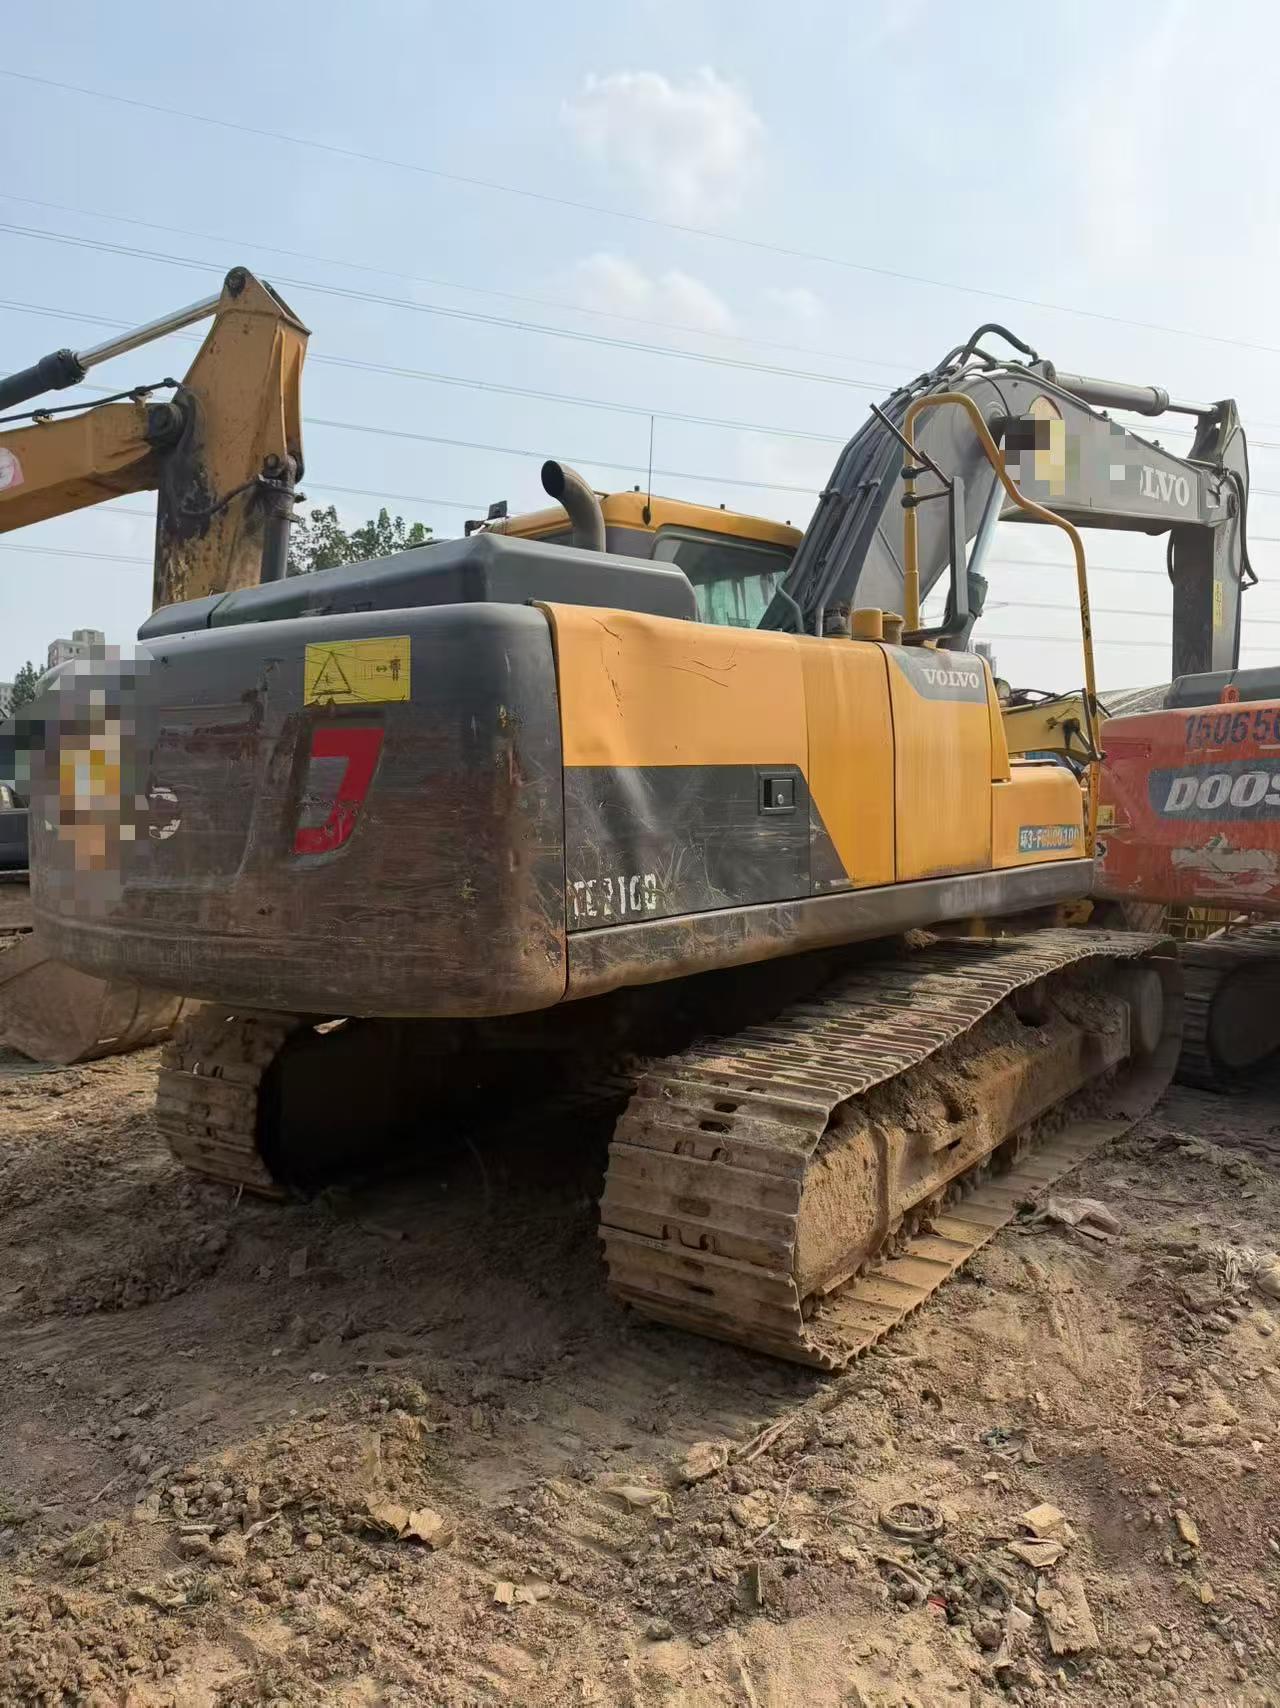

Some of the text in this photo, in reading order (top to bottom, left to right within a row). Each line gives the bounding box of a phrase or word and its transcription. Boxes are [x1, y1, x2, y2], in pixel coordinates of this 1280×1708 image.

[1139, 465, 1190, 506] LVO
[921, 668, 979, 689] VOLVO
[1185, 708, 1280, 746] 15065
